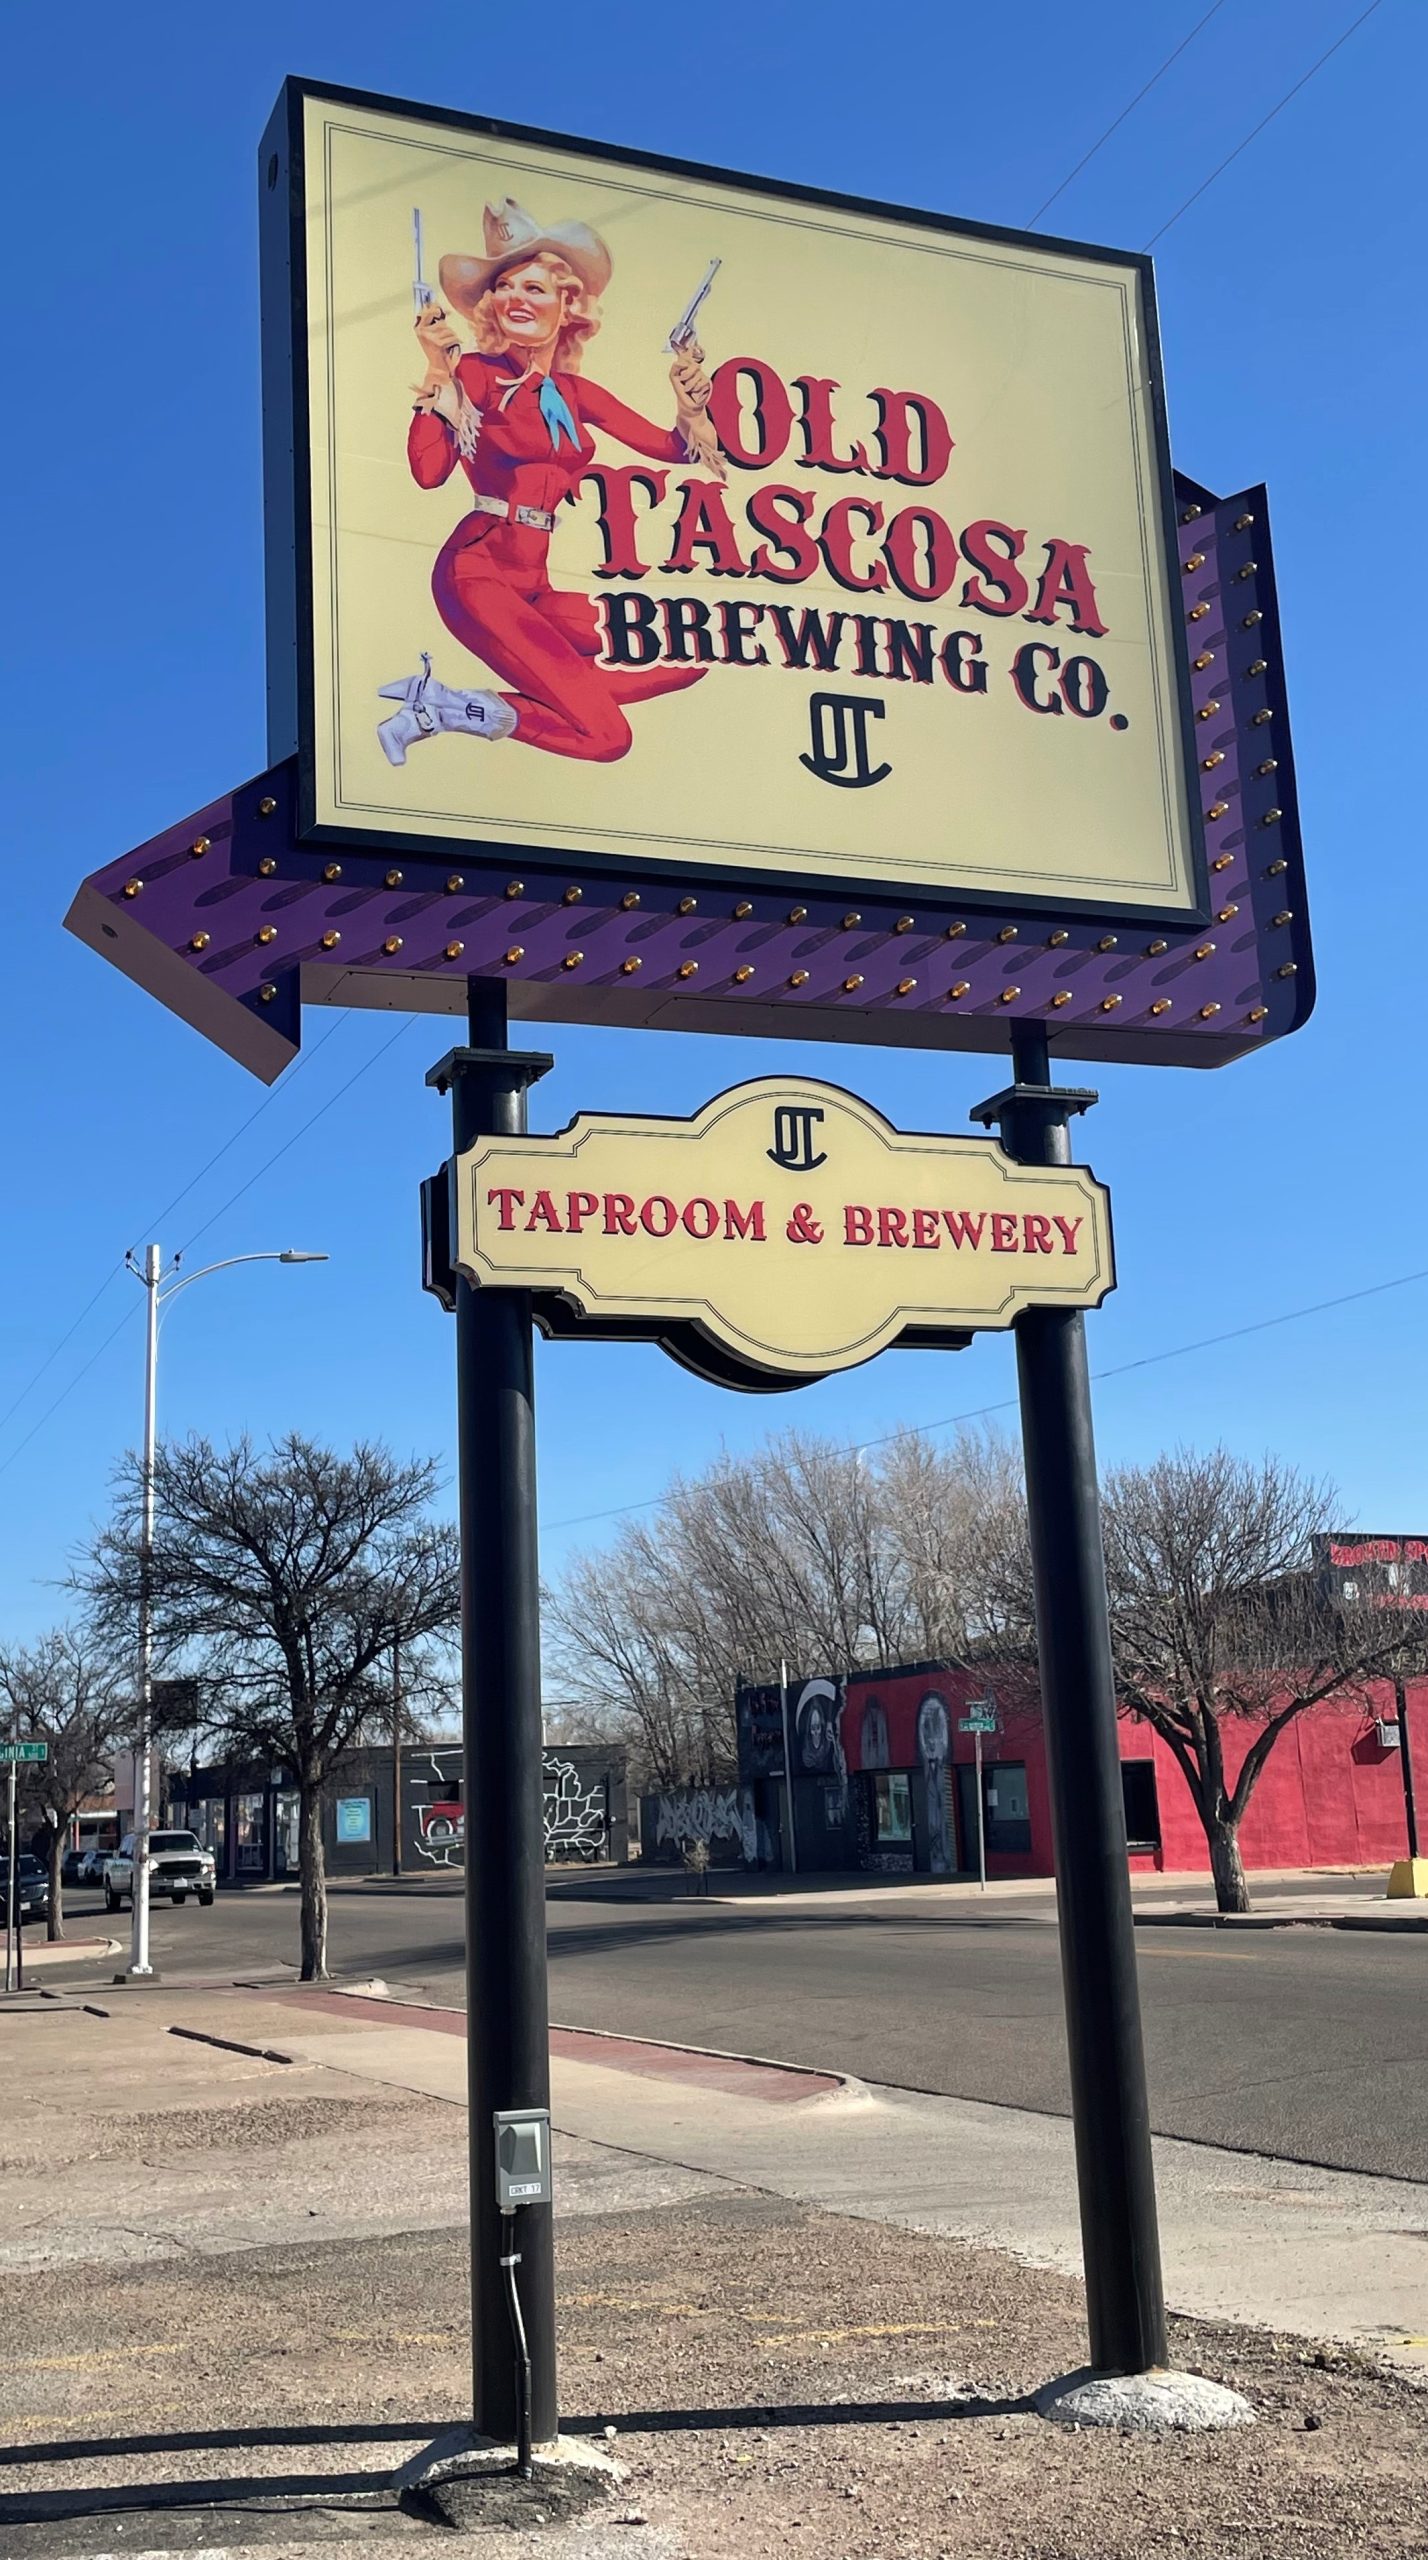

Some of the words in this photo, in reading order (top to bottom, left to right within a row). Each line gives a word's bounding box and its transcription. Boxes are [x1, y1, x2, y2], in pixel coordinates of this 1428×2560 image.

[708, 356, 956, 487] OLD
[565, 464, 1111, 638] TASCOSA
[598, 592, 989, 695] BREWING
[1009, 642, 1130, 731] CO.
[487, 1188, 768, 1243] TAPROOM
[785, 1203, 824, 1245] &
[843, 1205, 1085, 1255] BREWERY
